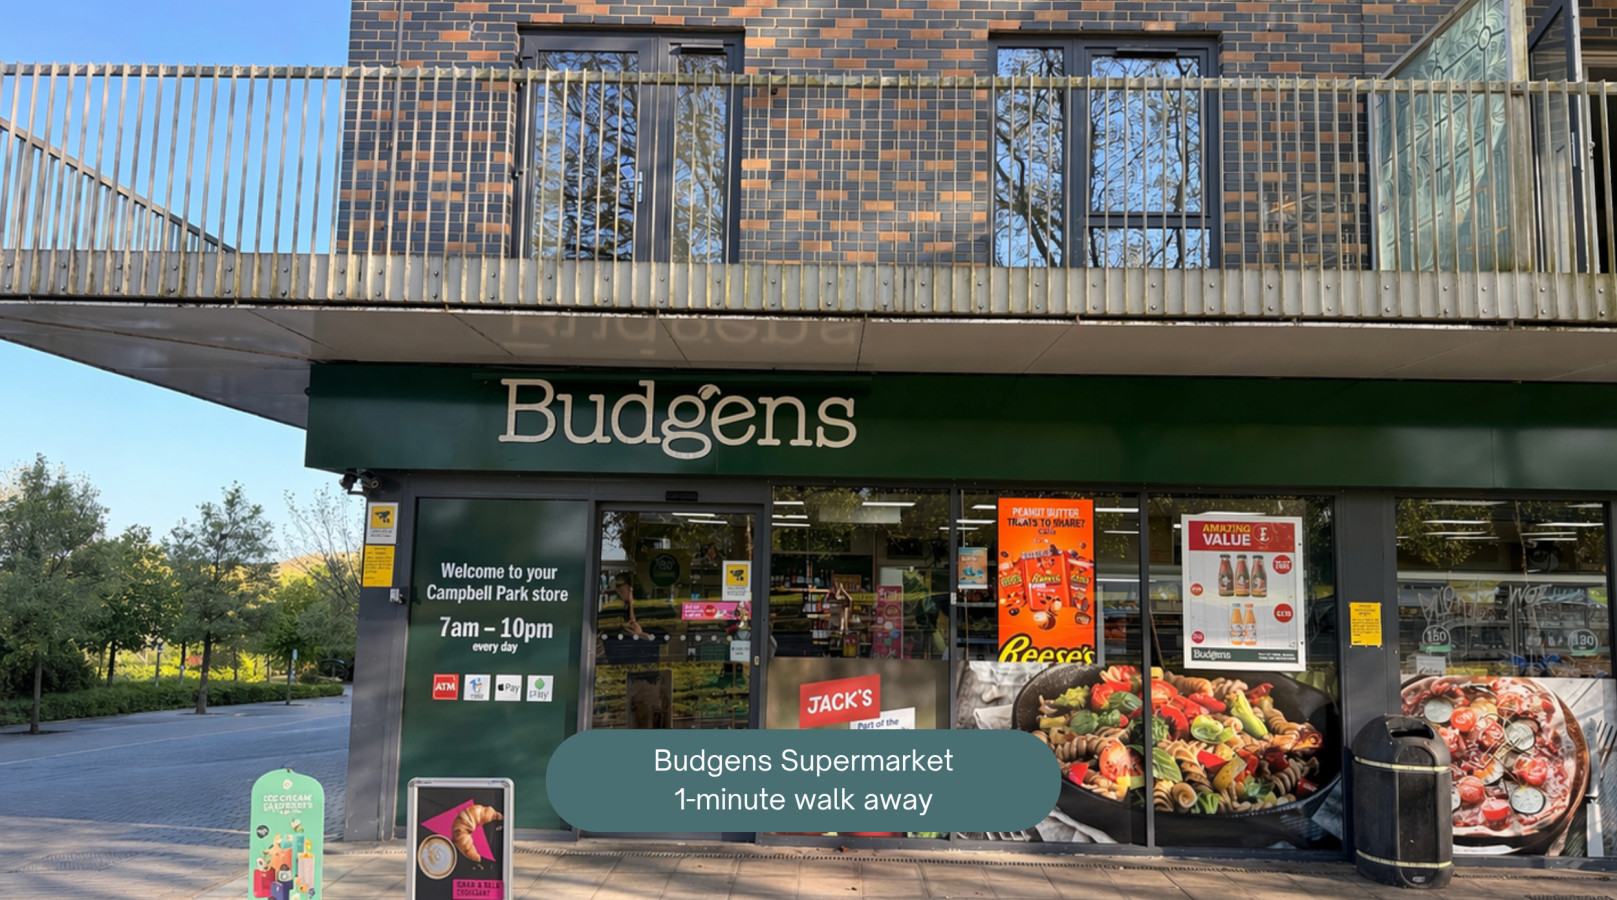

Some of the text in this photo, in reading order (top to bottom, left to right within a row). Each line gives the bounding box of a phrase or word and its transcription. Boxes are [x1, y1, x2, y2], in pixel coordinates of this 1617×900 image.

[498, 378, 857, 460] Budgens
[1012, 507, 1080, 518] PEANUT BUTTER
[1007, 518, 1086, 528] TREATS TO SHARE?
[1202, 524, 1251, 533] AMAZING
[1202, 533, 1252, 546] VALUE
[441, 562, 558, 583] Welcome to your
[427, 584, 569, 604] Campbell Park store
[440, 616, 479, 638] 7am
[500, 617, 553, 643] 10pm
[472, 641, 518, 654] every day
[998, 635, 1095, 664] Reese's
[435, 682, 456, 691] ATM
[505, 683, 520, 694] Pay
[807, 688, 873, 714] JACK'S
[857, 718, 899, 729] Part of the
